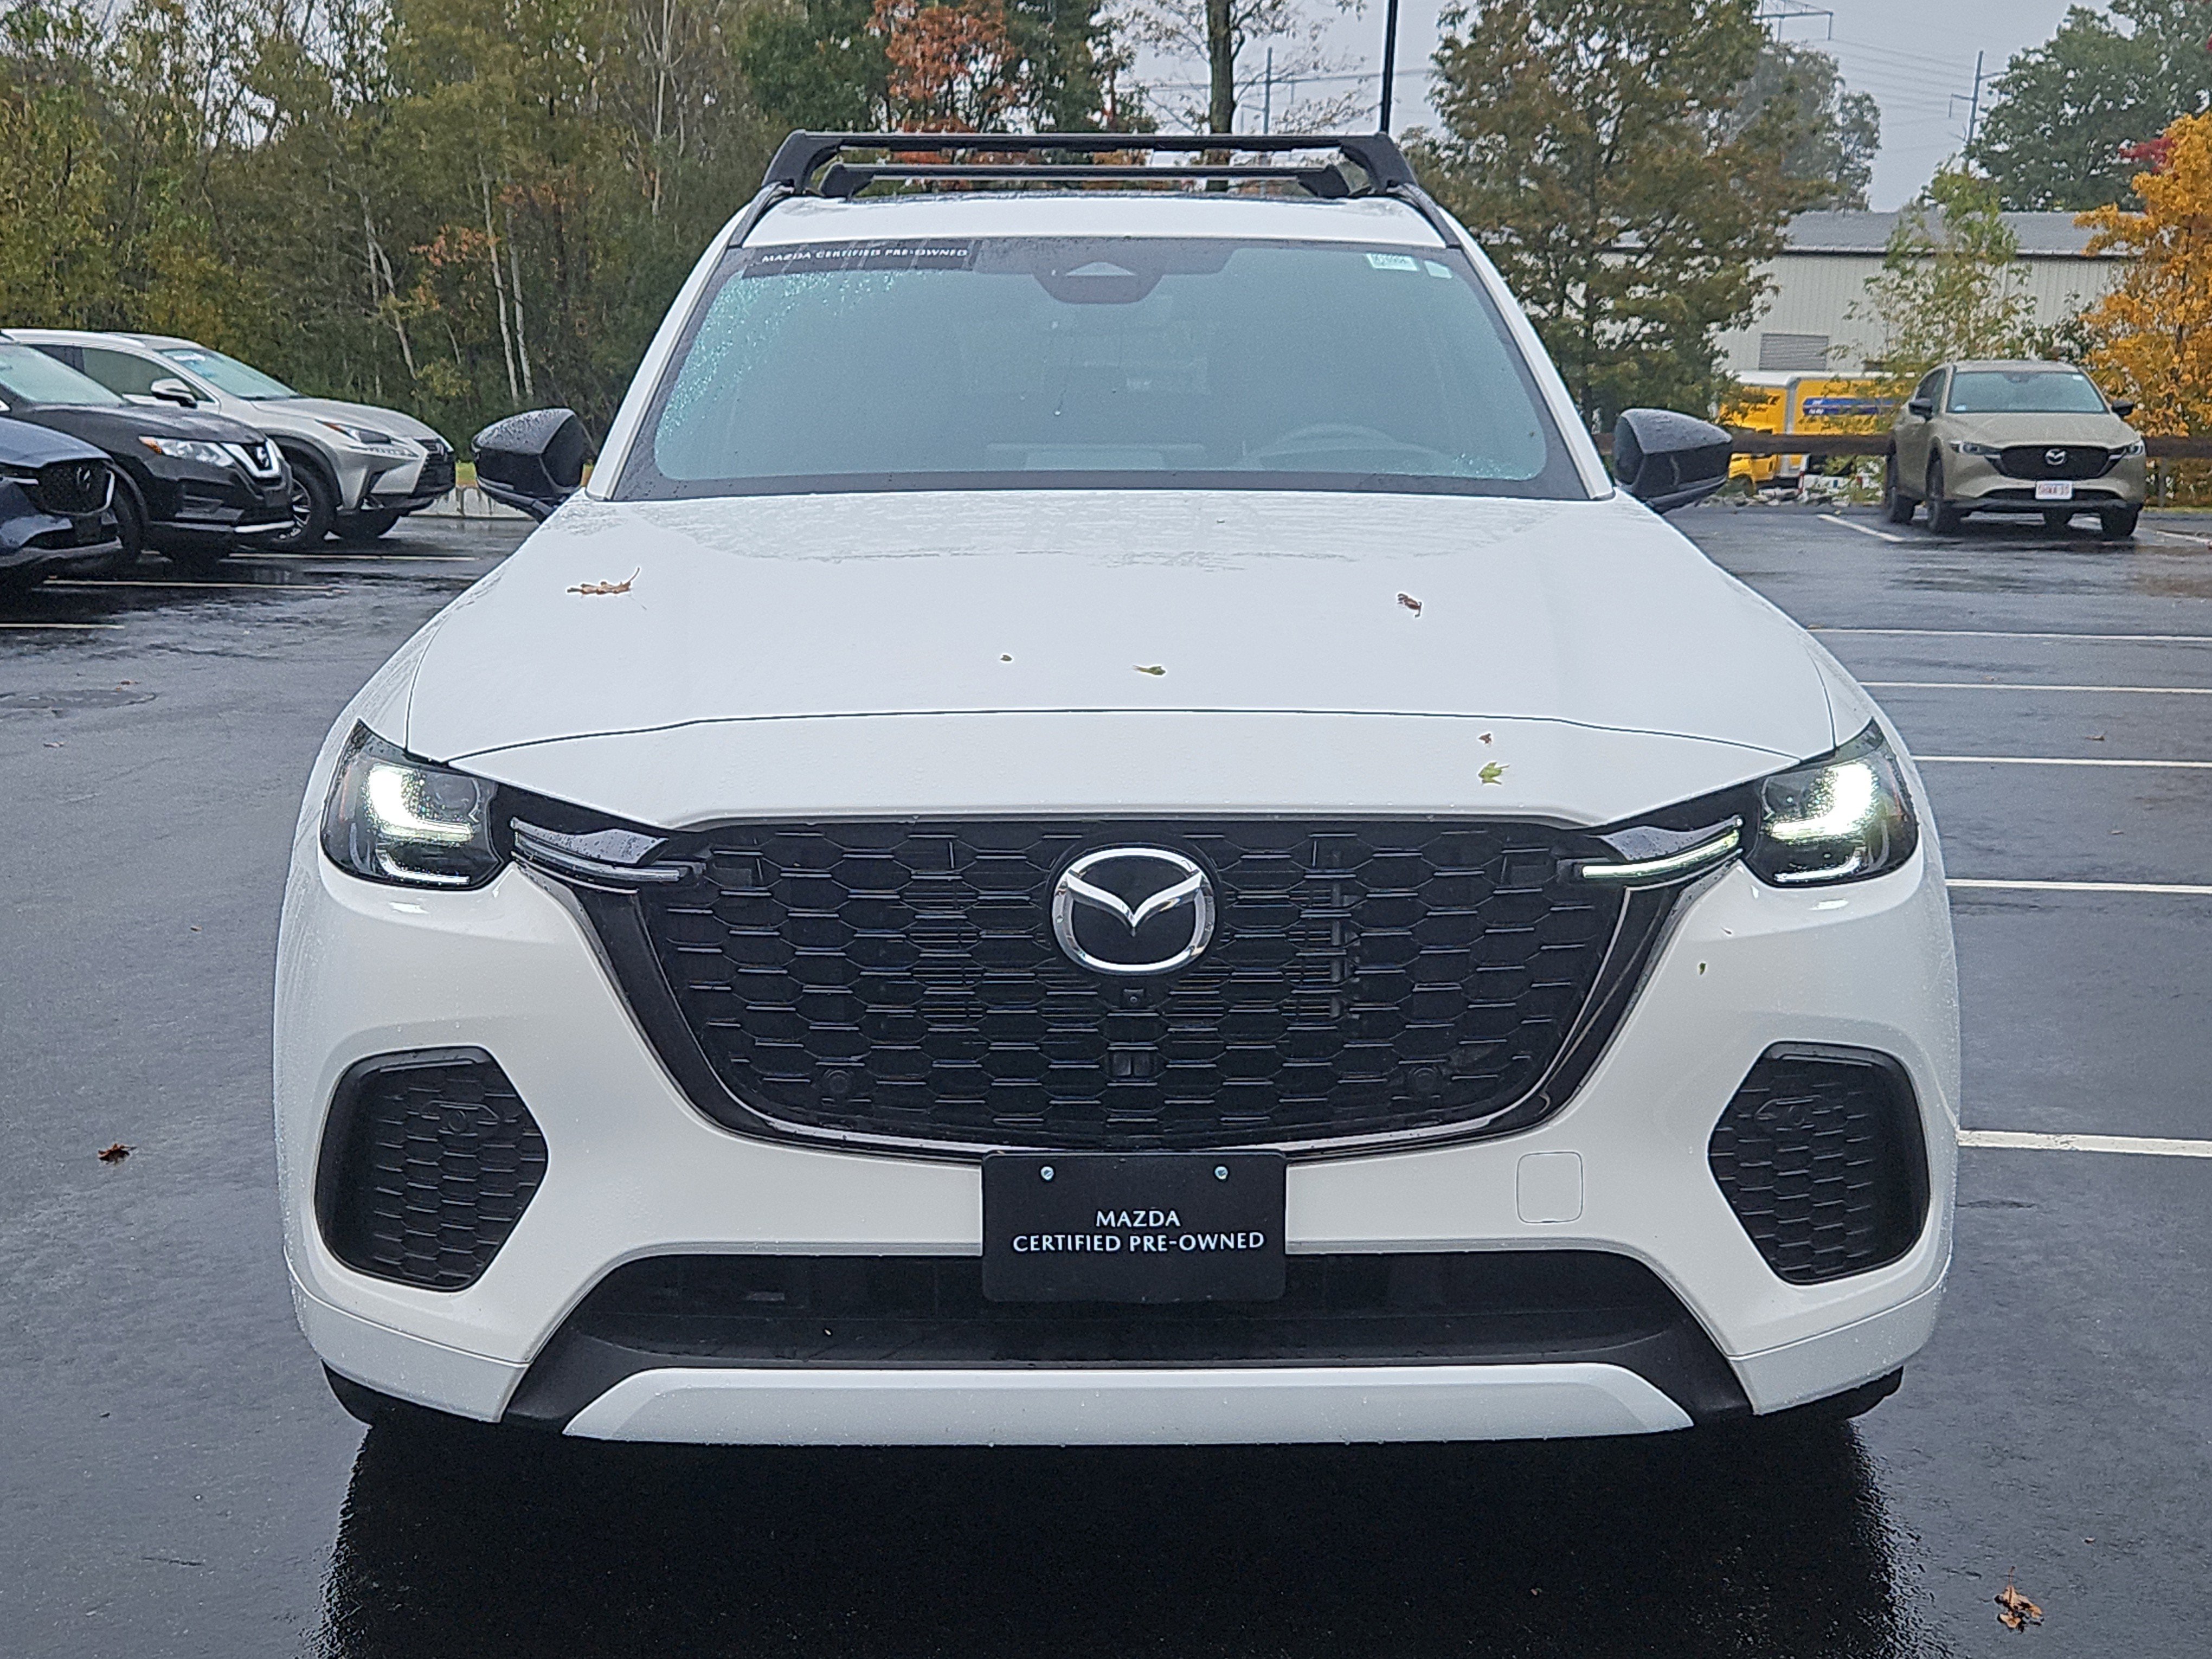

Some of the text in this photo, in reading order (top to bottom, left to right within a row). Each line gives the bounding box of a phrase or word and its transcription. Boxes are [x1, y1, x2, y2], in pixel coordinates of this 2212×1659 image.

[762, 252, 811, 263] MAZDA
[815, 249, 882, 259] CERTIFIED
[1095, 1210, 1181, 1227] MAZDA
[1012, 1231, 1265, 1252] CERTIFIED PRE-OWNED
